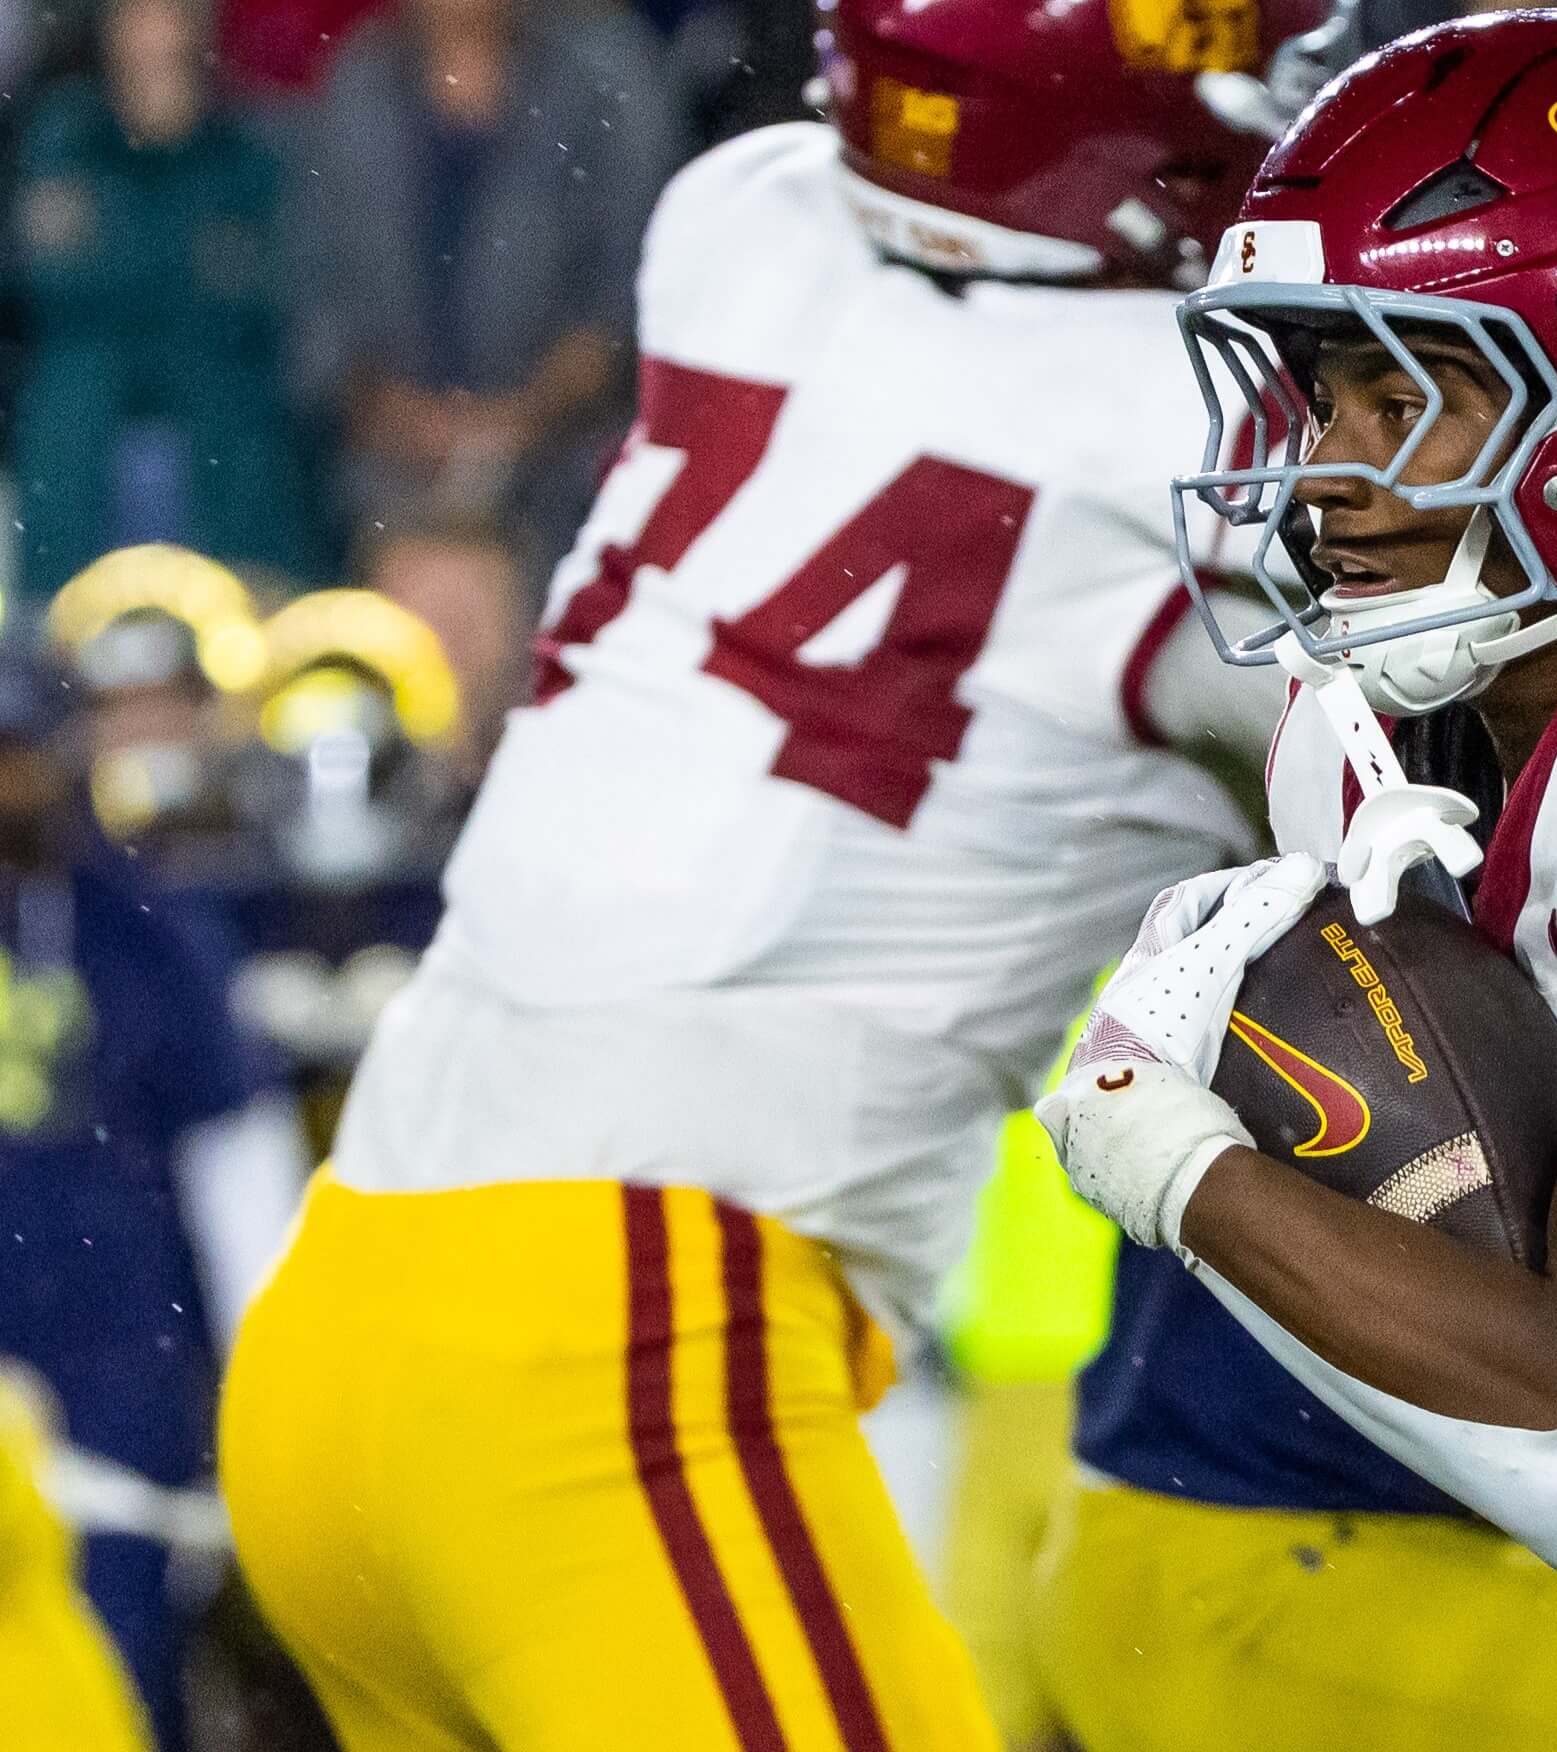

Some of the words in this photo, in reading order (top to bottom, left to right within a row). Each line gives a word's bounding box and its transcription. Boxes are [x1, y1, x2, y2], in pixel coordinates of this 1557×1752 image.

[533, 355, 1037, 831] 74
[1320, 922, 1380, 988] ELITE
[1367, 983, 1429, 1084] VAPOR
